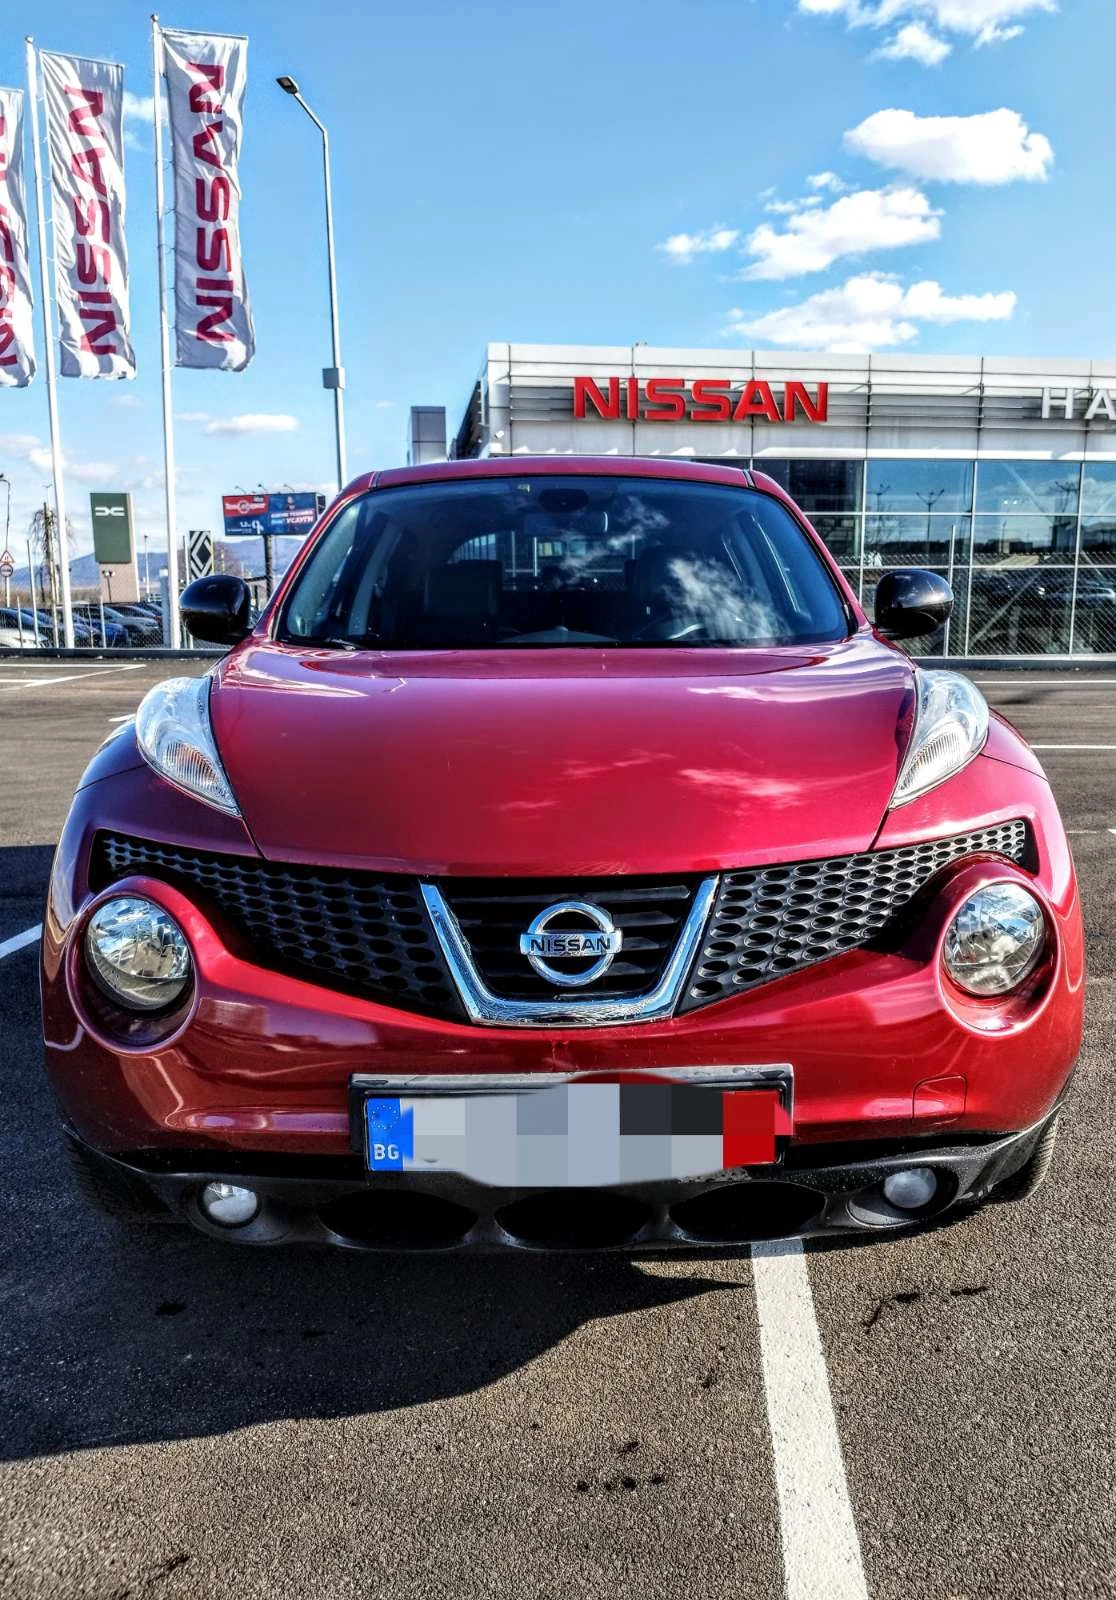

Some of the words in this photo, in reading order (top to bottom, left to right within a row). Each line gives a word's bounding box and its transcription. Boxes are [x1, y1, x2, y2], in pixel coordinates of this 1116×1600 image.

[64, 84, 116, 356] NISSAN
[186, 61, 235, 342] NISSAN
[573, 376, 829, 423] NISSAN
[1041, 387, 1116, 421] HA
[530, 936, 611, 952] NISSAN
[373, 1144, 399, 1161] BG
